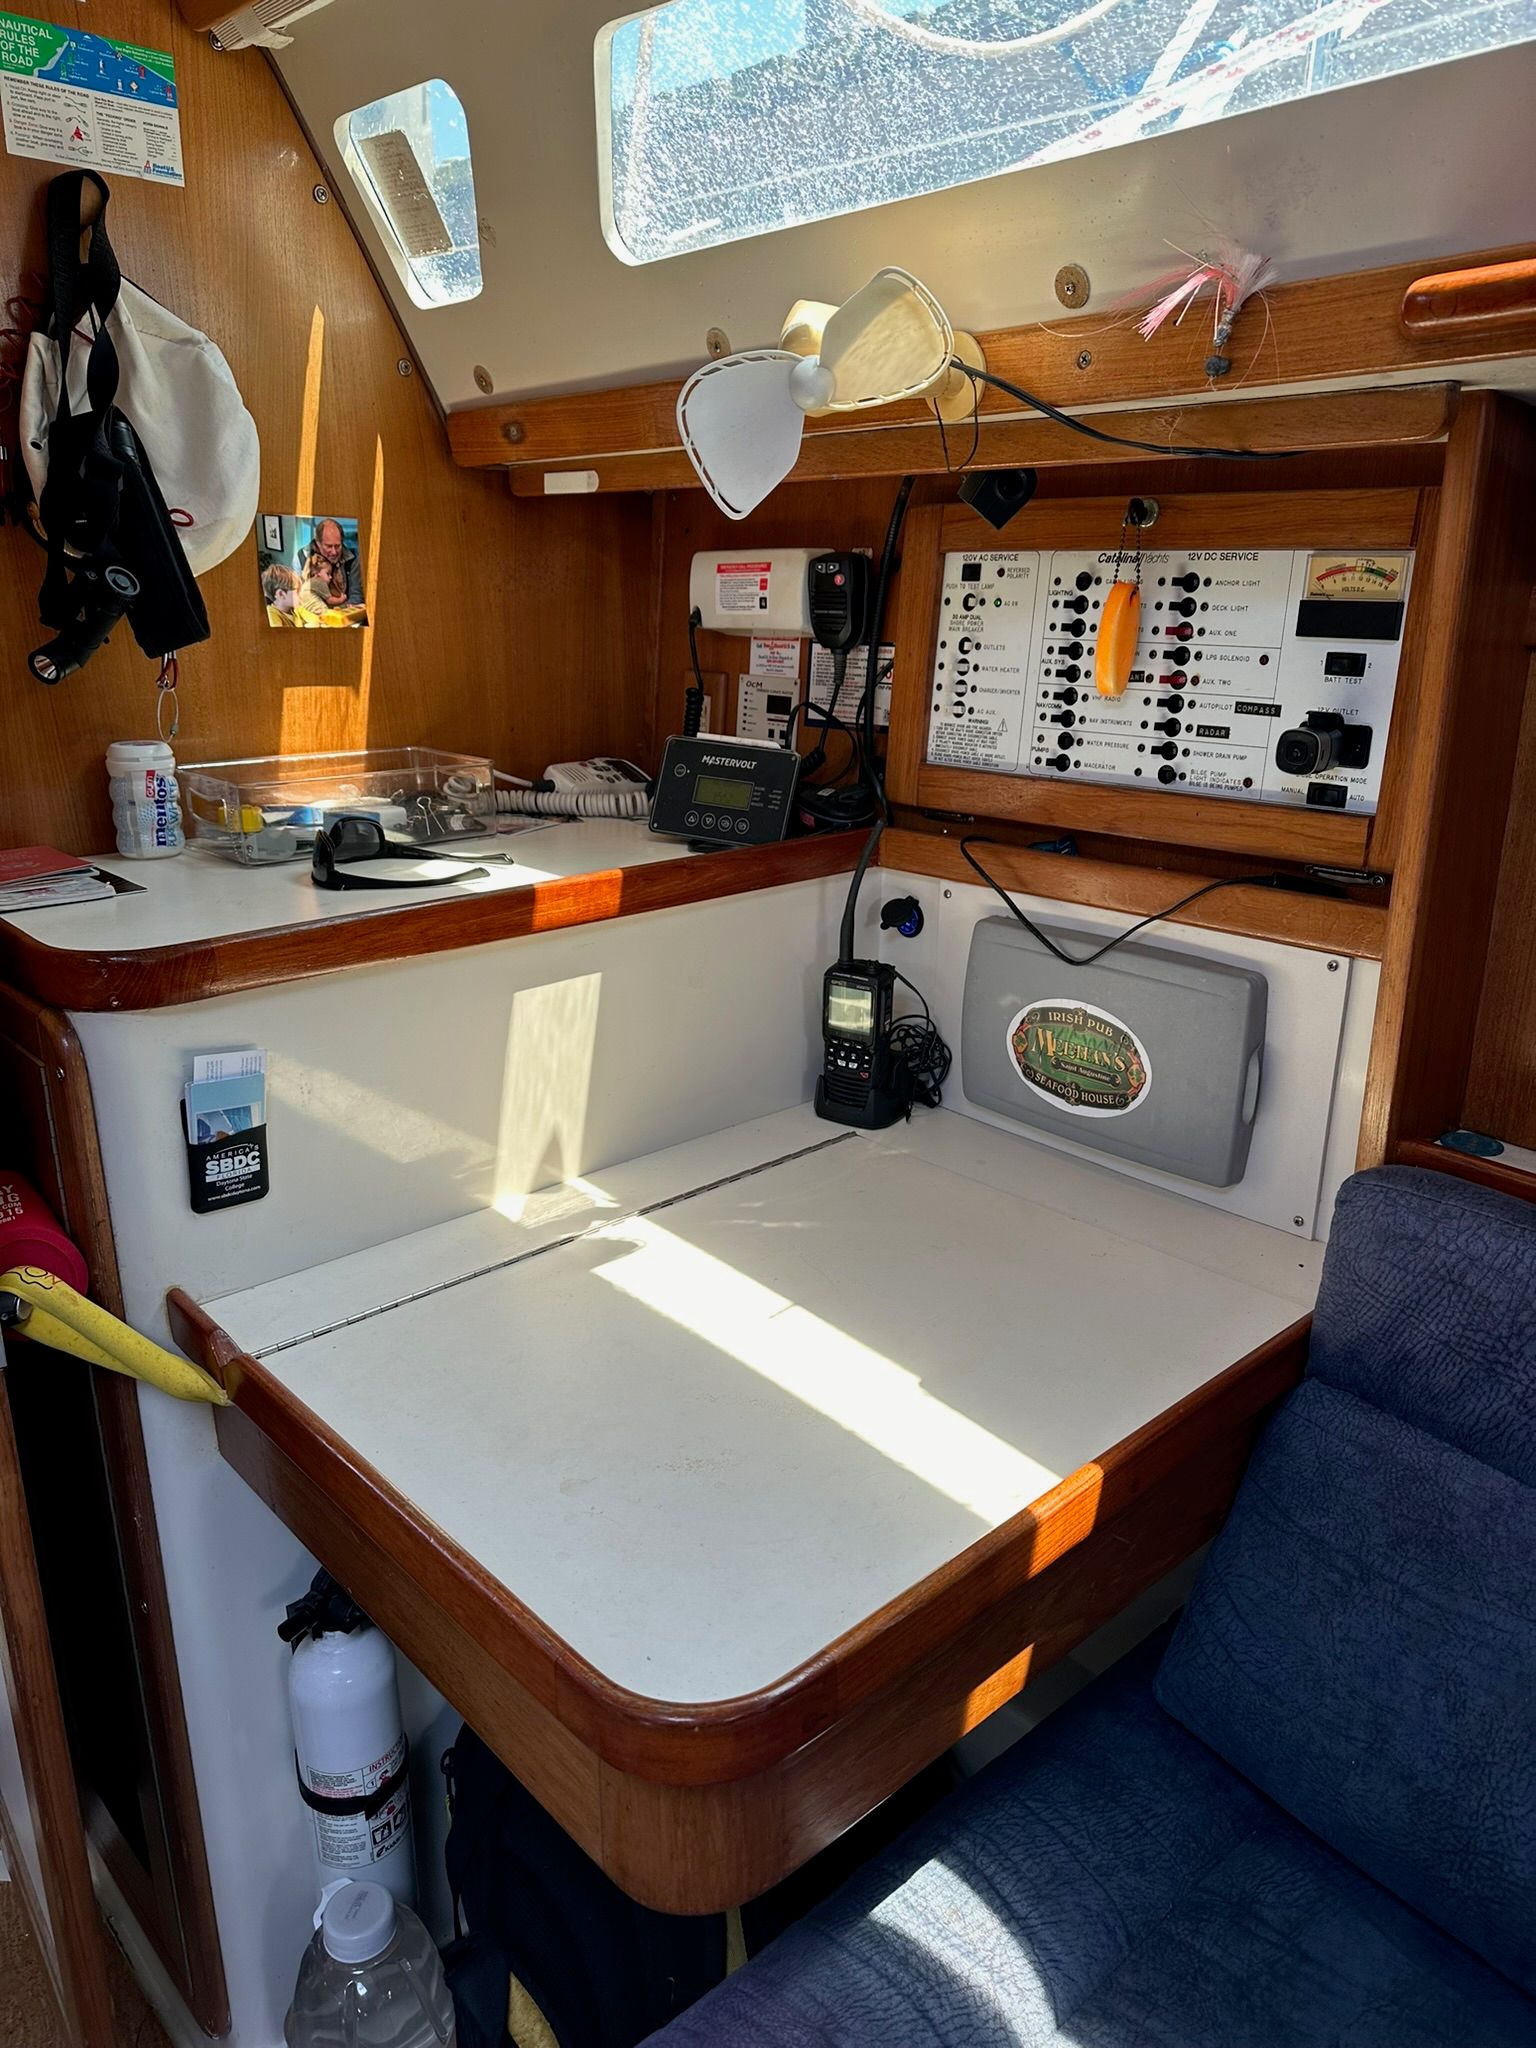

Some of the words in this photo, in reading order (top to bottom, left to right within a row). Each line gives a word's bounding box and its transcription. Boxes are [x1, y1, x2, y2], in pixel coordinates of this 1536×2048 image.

[0, 18, 53, 40] NAUTICAL
[0, 28, 36, 46] RULES
[0, 40, 15, 52] OF
[17, 43, 40, 58] THE
[2, 51, 33, 66] ROAD
[1188, 552, 1202, 560] 12V
[1204, 552, 1217, 561] DC
[1219, 552, 1259, 561] SERVICE
[1236, 704, 1276, 714] COMPASS
[1199, 728, 1226, 736] RADAR
[701, 755, 757, 769] MASTERVOLT
[1315, 773, 1348, 782] OPERATION
[1281, 786, 1305, 794] MANUAL
[154, 777, 168, 846] mentos
[1049, 1011, 1083, 1024] IRISH
[1087, 1019, 1113, 1037] PUB
[1034, 1074, 1079, 1099] SEAFOOD
[1081, 1092, 1115, 1105] HOUSE
[205, 1151, 260, 1174] SBDC
